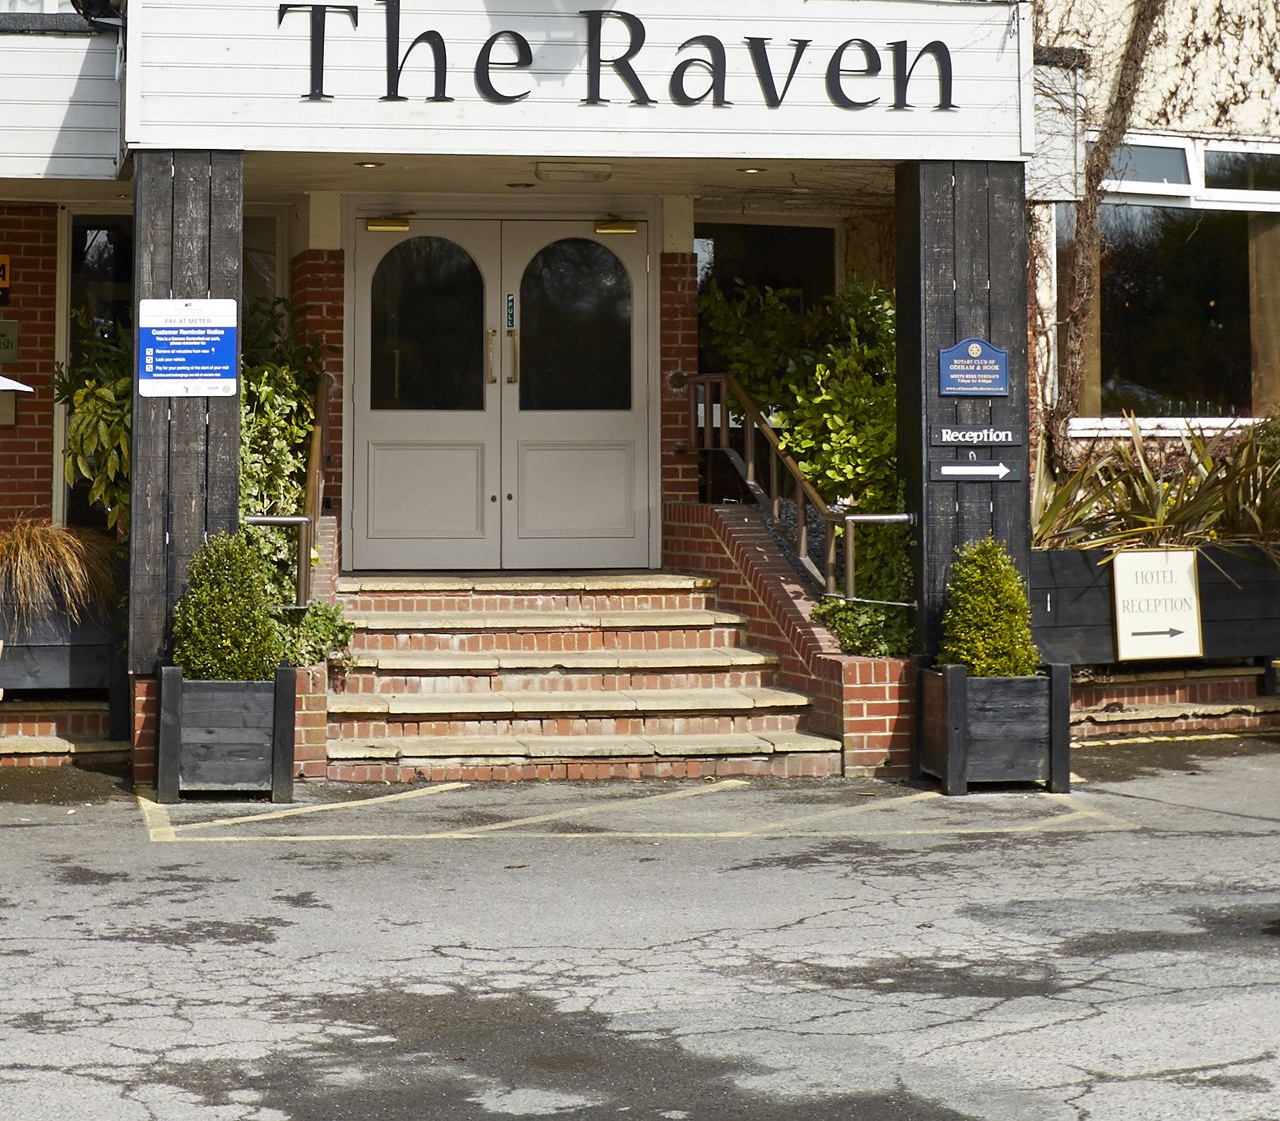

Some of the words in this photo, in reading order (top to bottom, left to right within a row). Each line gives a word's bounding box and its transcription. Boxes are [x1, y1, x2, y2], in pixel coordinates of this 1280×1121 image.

[578, 9, 958, 111] Raven
[941, 428, 1013, 444] Reception
[1135, 568, 1178, 585] HOTEL
[1122, 597, 1193, 614] RECEPTION
